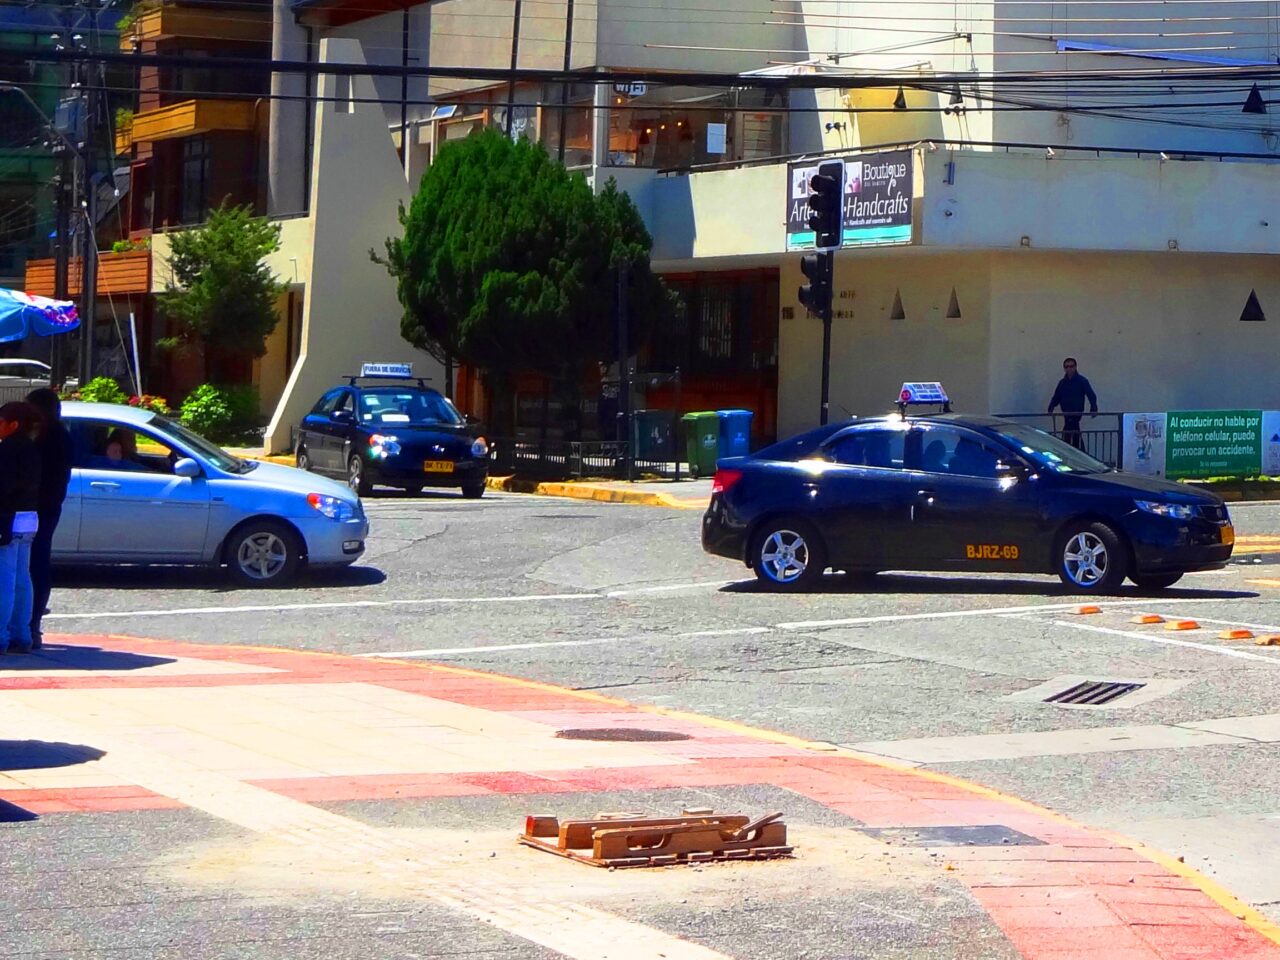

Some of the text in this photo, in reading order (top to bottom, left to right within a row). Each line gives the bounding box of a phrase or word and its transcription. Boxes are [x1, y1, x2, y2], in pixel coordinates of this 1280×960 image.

[863, 162, 907, 196] Boutique
[790, 192, 909, 222] Arte Handcrafts
[1170, 416, 1260, 429] Al conducir no hable por
[1173, 429, 1256, 443] teléfono celular, puede
[1172, 444, 1256, 460] provocar un accidente.
